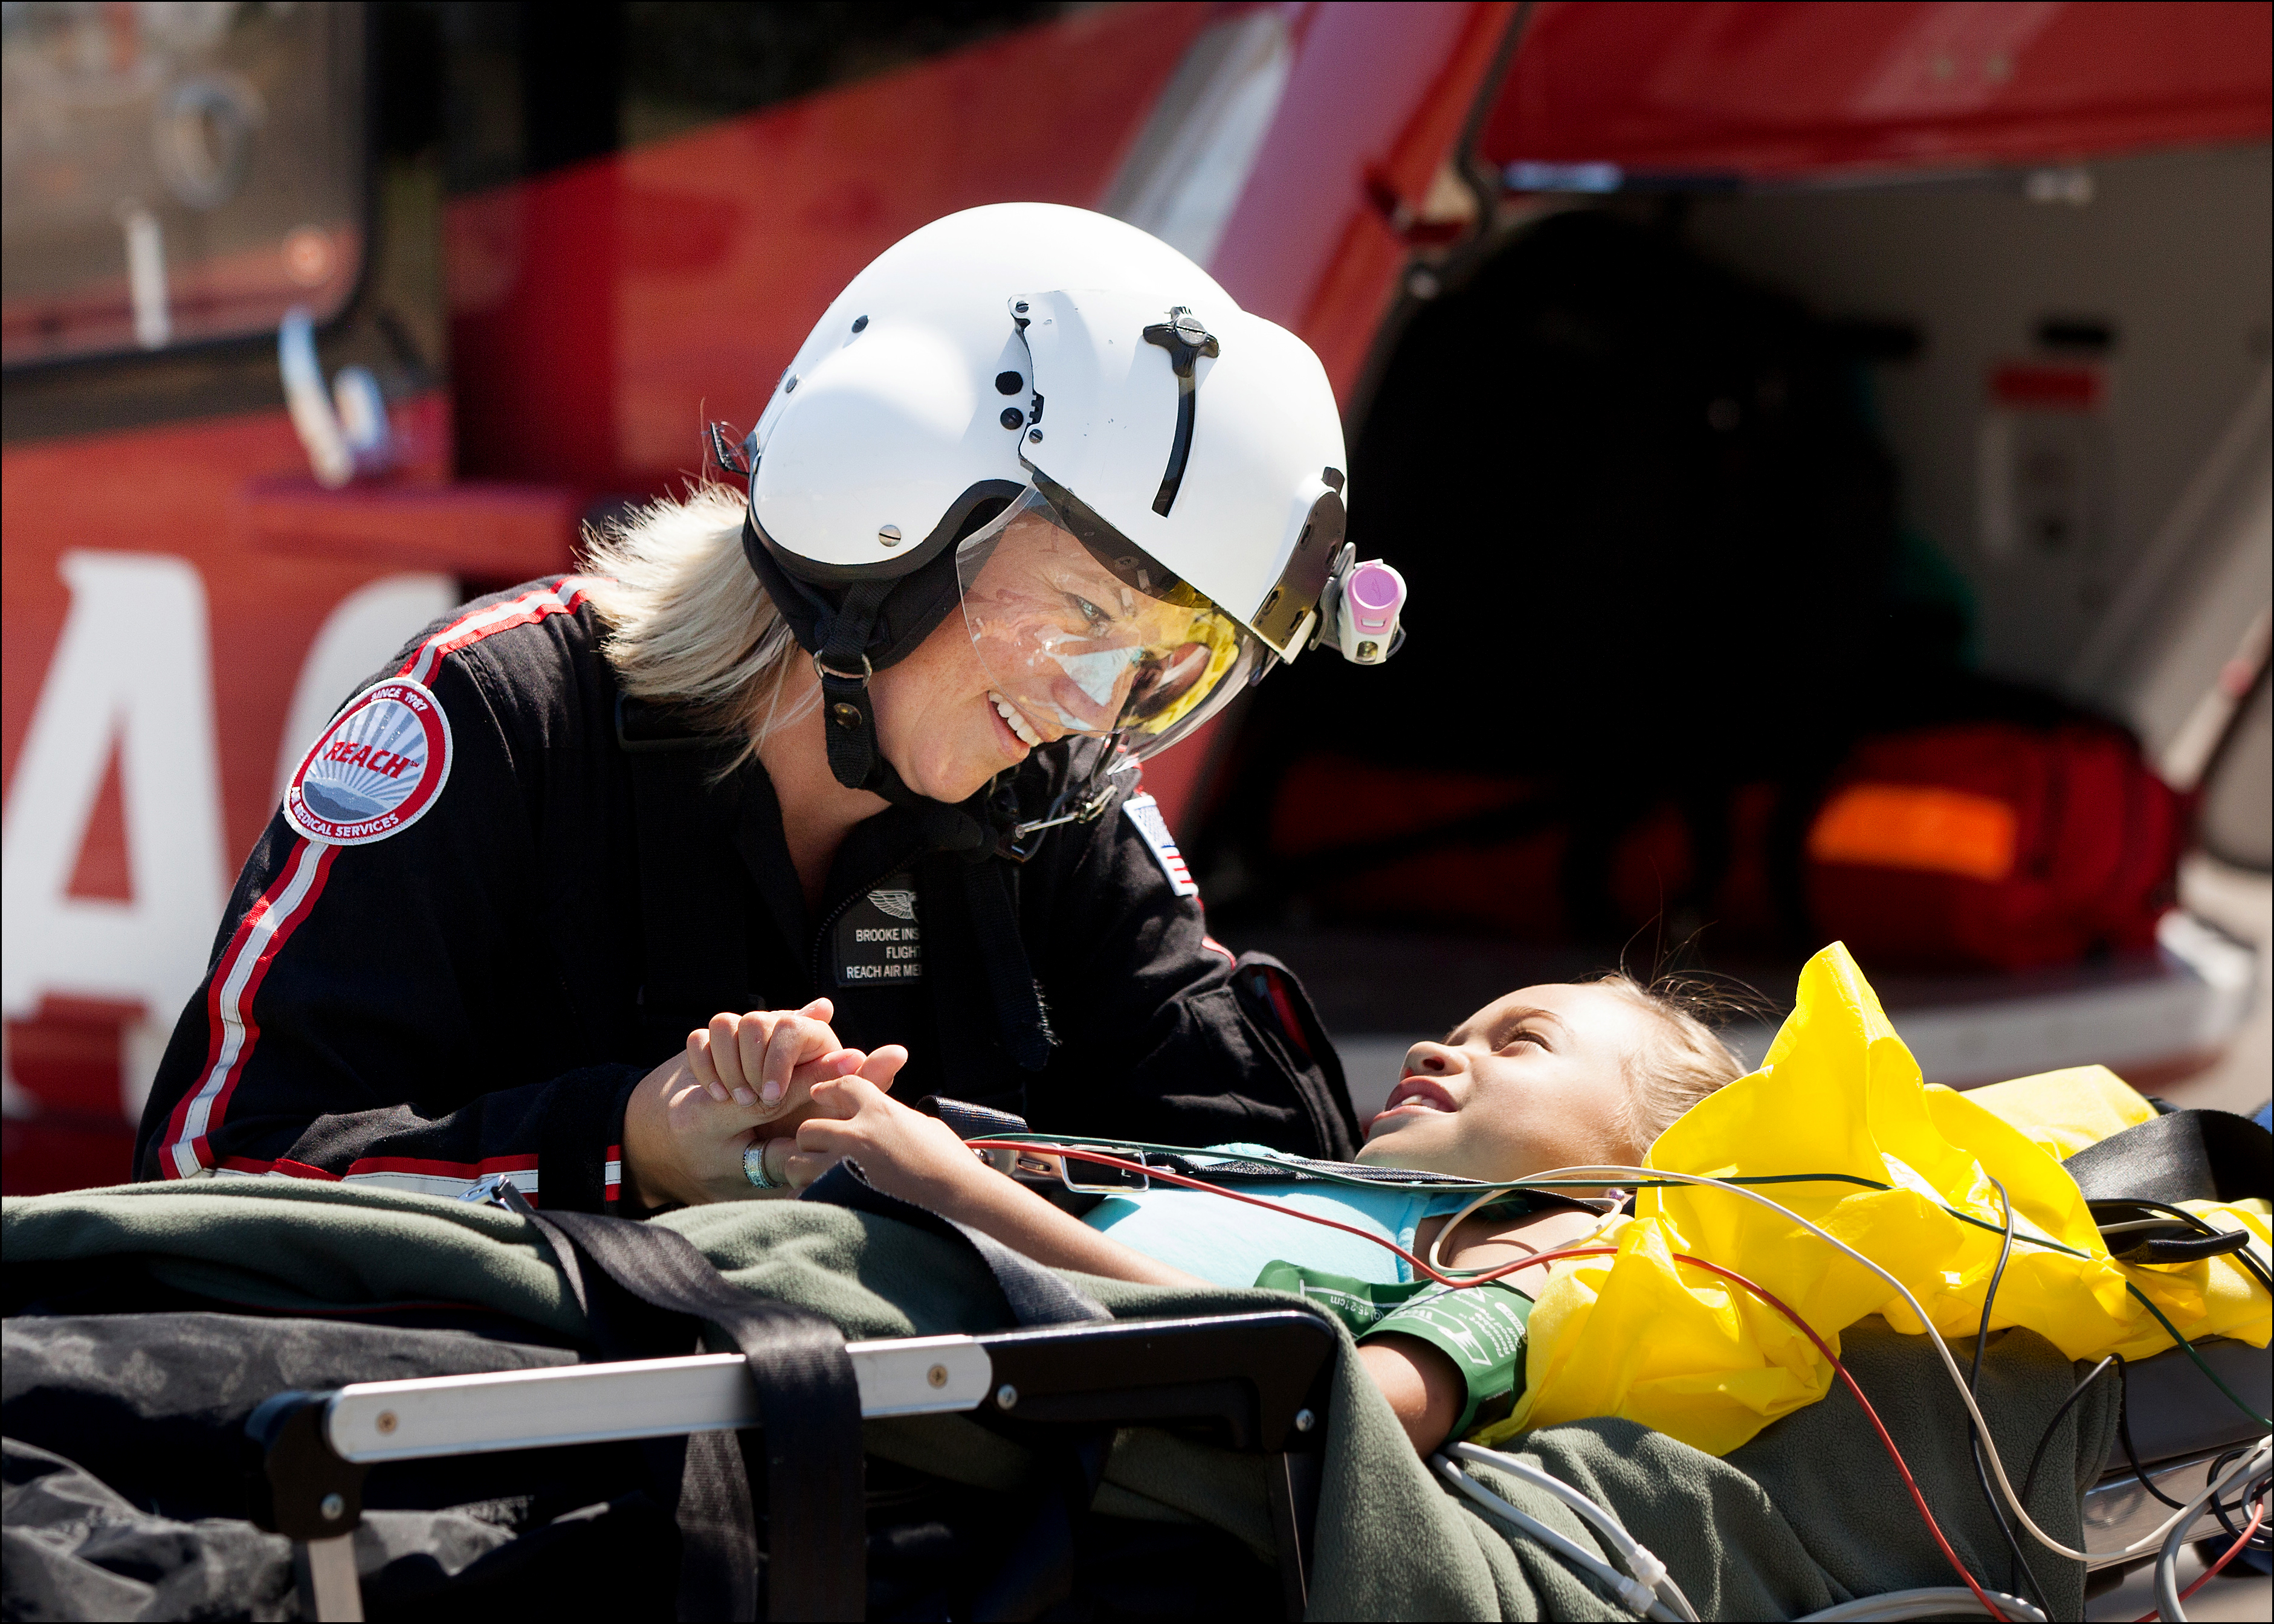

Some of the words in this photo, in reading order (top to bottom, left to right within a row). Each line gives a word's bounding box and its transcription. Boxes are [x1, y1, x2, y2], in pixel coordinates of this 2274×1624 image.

[370, 688, 402, 701] SINCE
[404, 692, 428, 712] 1987
[323, 740, 411, 779] REACH
[335, 813, 399, 837] SERVICES
[855, 929, 900, 942] BROOKE
[847, 965, 882, 979] REACH
[883, 964, 901, 978] AIR
[1452, 1295, 1496, 1321] Pressure
[1475, 1312, 1510, 1355] Reusable
[1493, 1322, 1516, 1352] Blood
[1506, 1311, 1528, 1342] CHILD
[1506, 1327, 1522, 1348] Cuff
